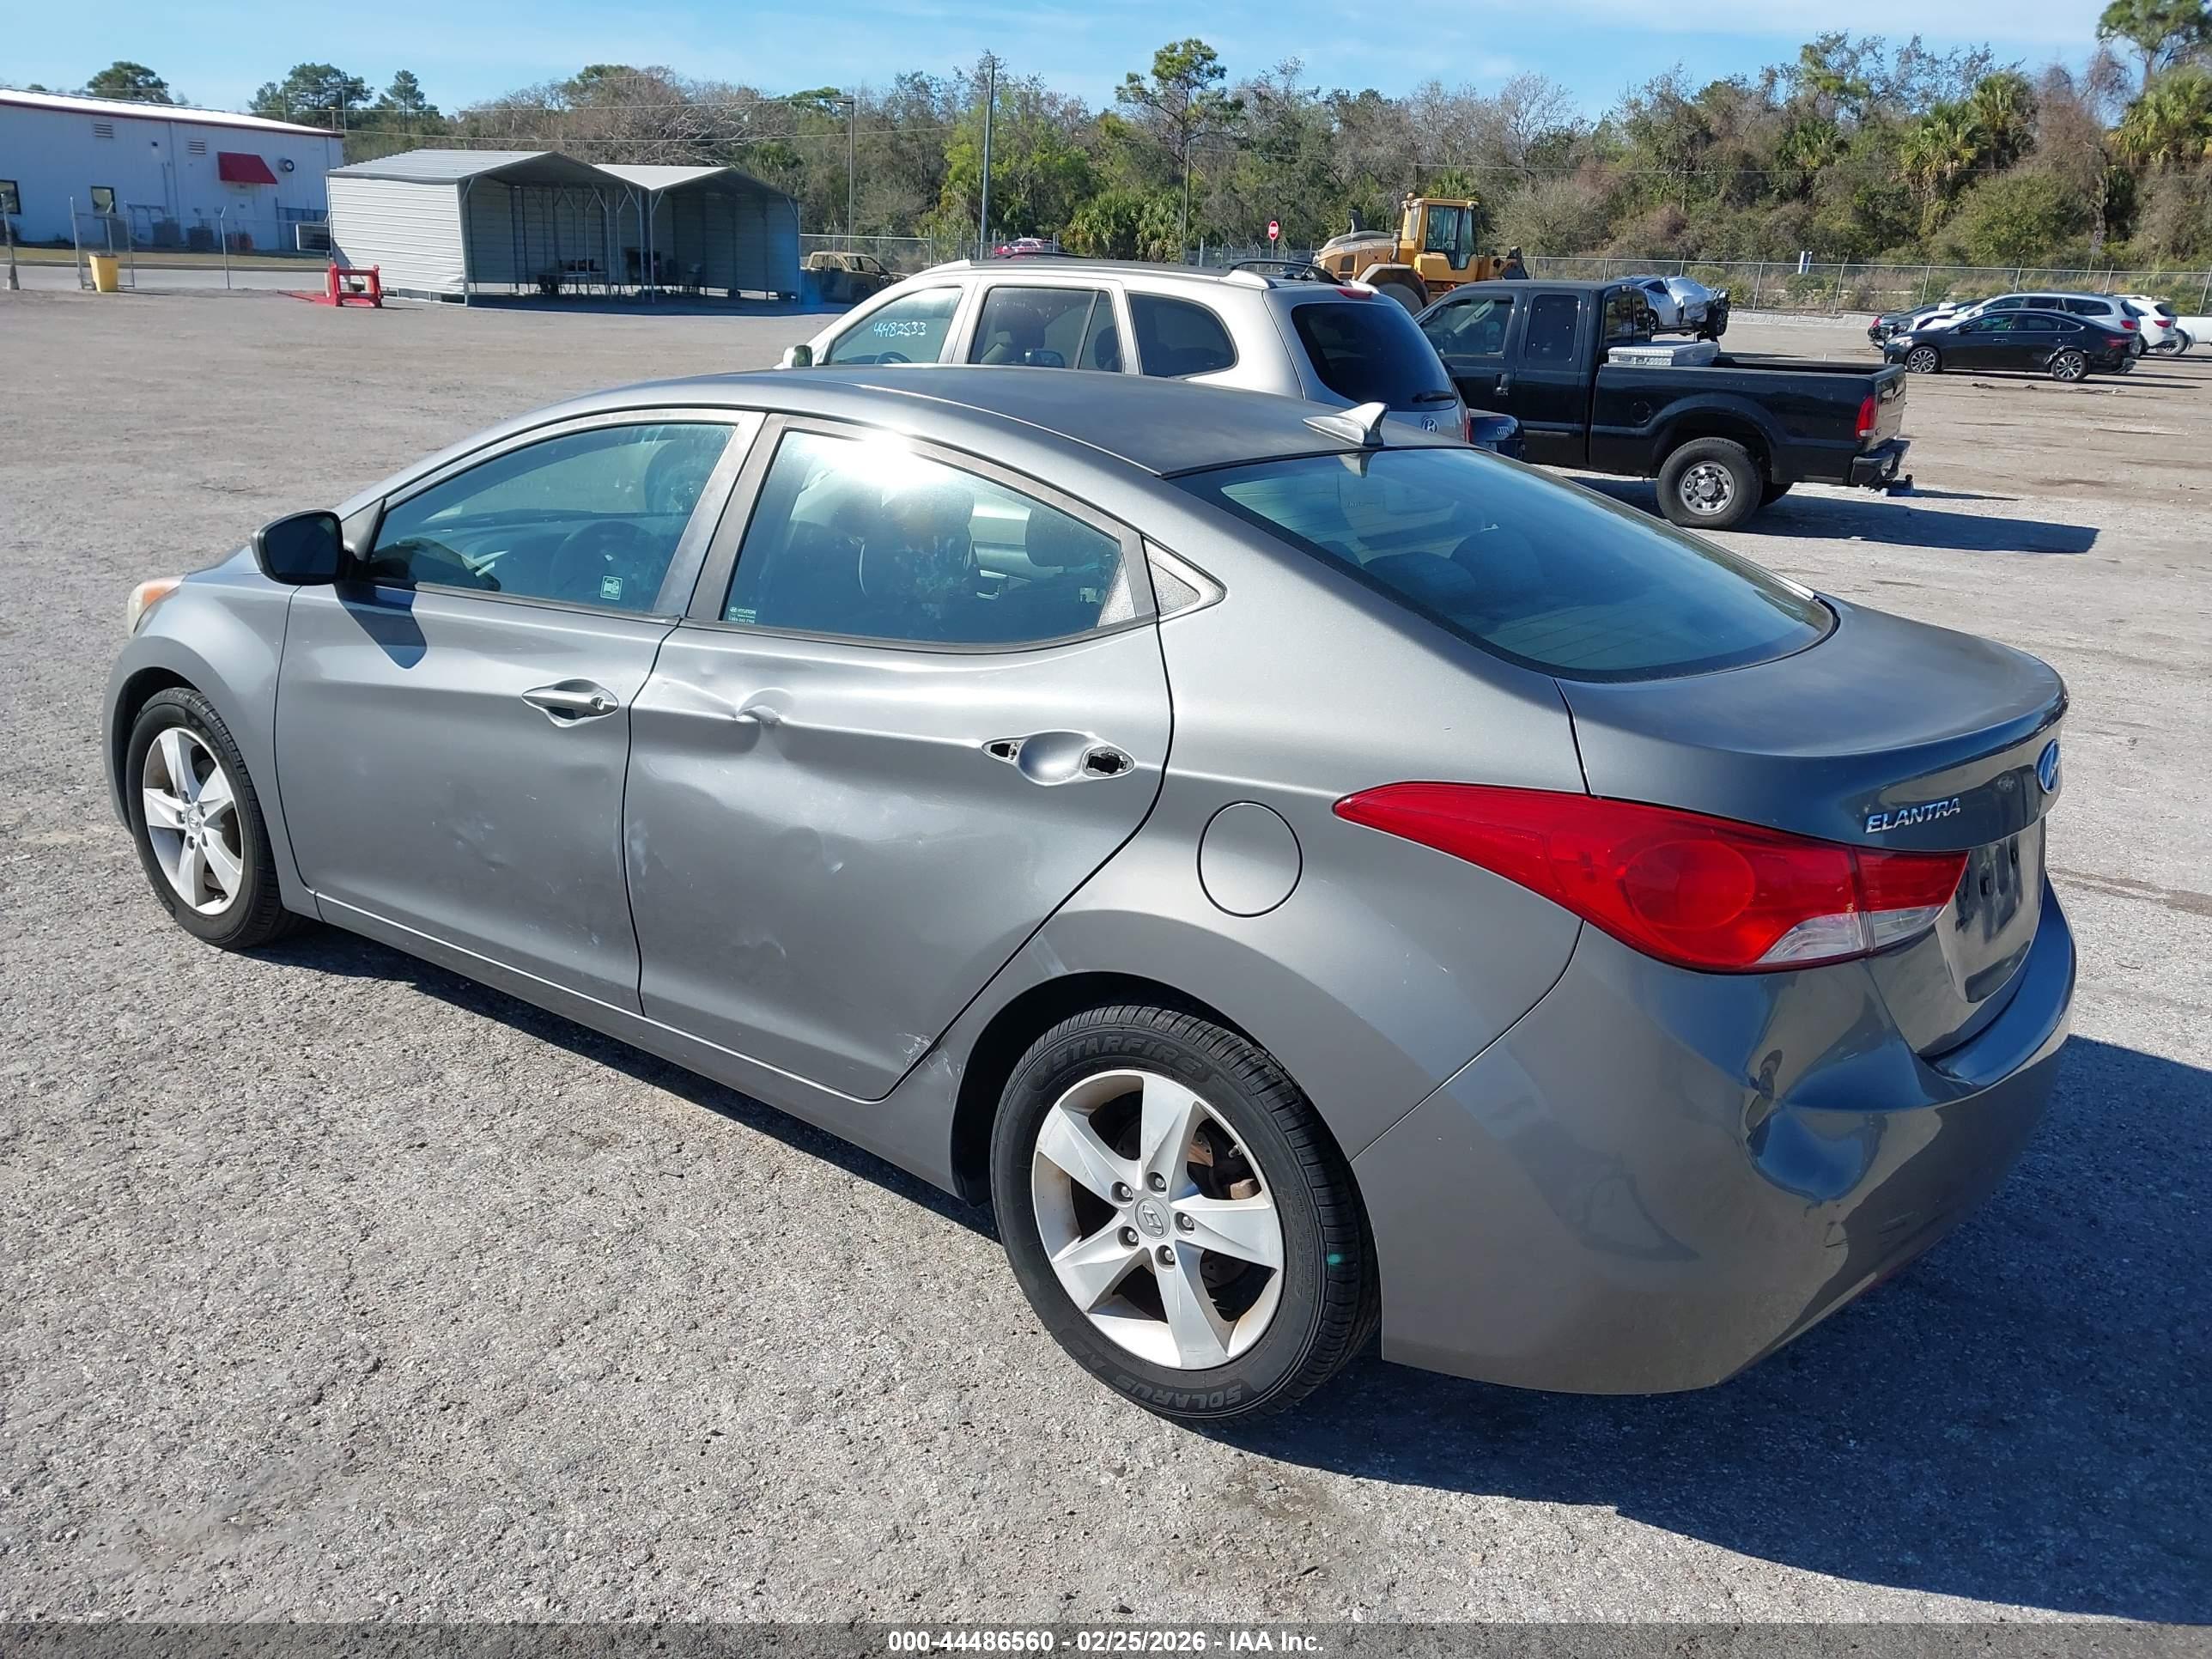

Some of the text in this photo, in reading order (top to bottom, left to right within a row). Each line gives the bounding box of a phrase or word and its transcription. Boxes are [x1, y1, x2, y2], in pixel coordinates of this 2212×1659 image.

[1864, 798, 1961, 834] ELANTRA
[1051, 1035, 1204, 1074] STARFIRE
[1111, 1372, 1243, 1410] SOLARUS
